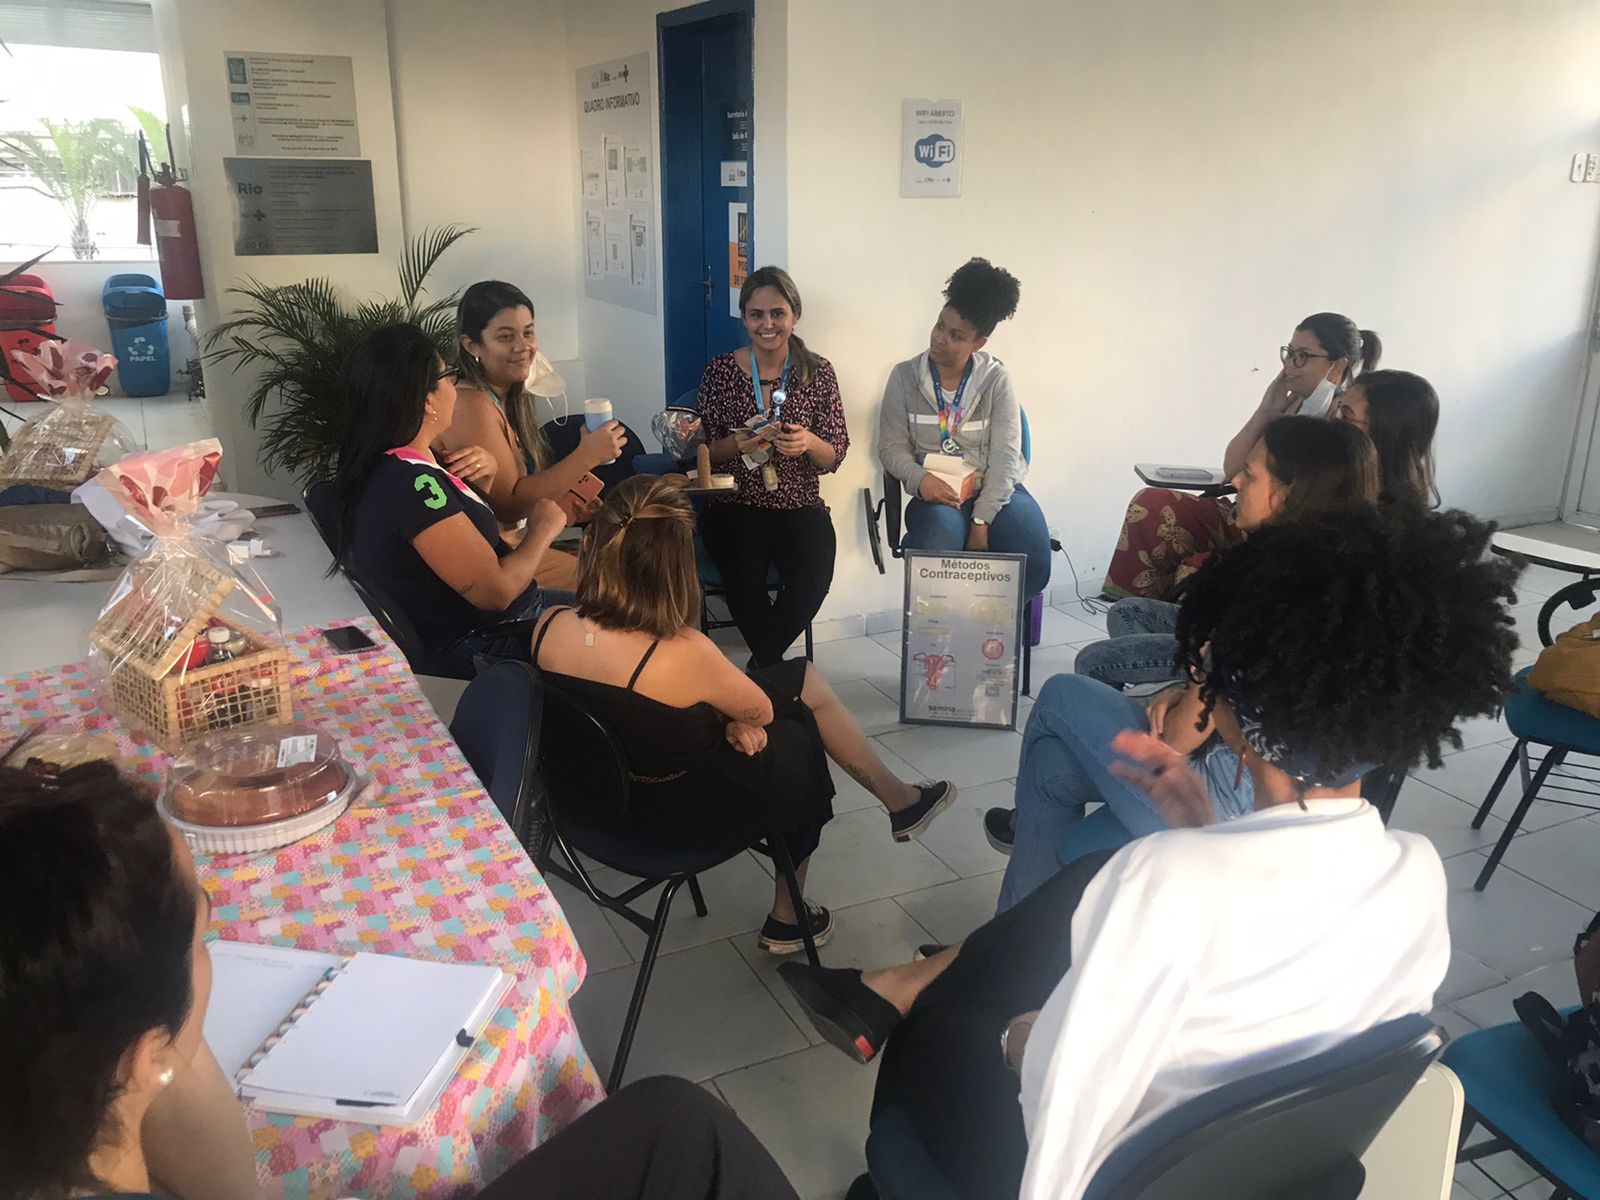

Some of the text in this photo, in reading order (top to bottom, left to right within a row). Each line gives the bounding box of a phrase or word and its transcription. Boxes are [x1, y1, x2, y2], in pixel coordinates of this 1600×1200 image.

[584, 92, 640, 113] QUADRO INFORMATIVO
[238, 183, 263, 195] Rio
[414, 473, 447, 510] 3
[941, 559, 990, 570] Métodos
[920, 568, 1011, 582] Contraceptivos
[928, 704, 956, 713] semina
